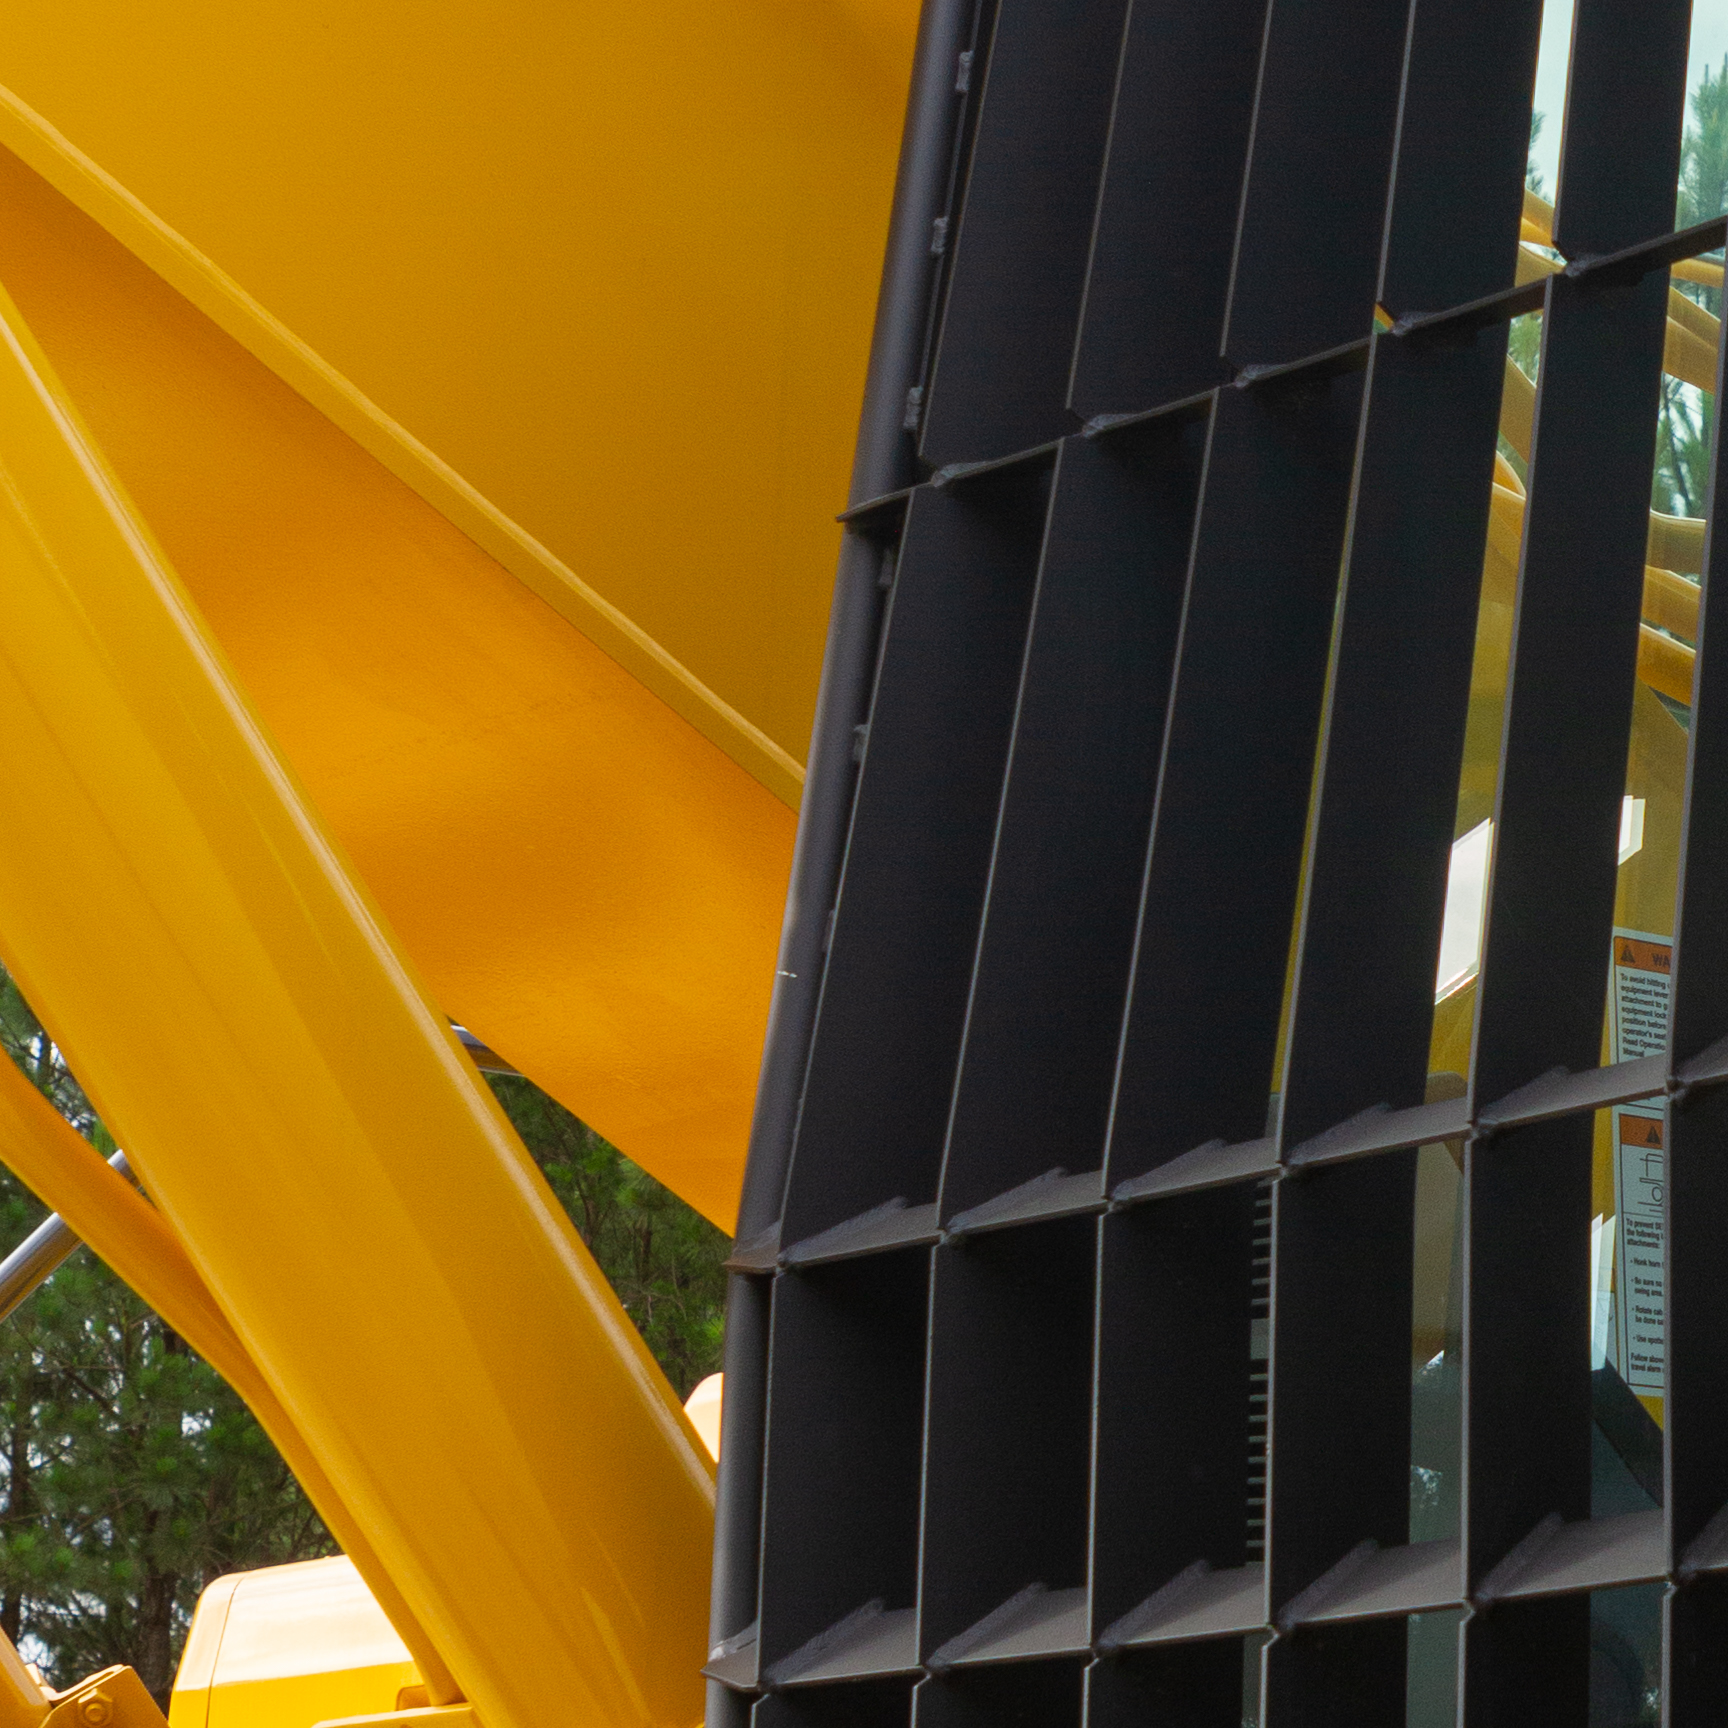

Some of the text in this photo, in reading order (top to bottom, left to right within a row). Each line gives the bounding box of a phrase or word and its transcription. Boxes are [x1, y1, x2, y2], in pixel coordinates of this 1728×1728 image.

[1621, 973, 1629, 981] To
[1630, 976, 1646, 985] avoid
[1621, 985, 1652, 996] equipment
[1622, 995, 1654, 1006] attachment
[1622, 1006, 1653, 1017] equipment
[1622, 1016, 1646, 1027] position
[1623, 1036, 1638, 1046] Read
[1623, 1047, 1644, 1058] Manual
[1626, 1218, 1633, 1226] To
[1635, 1221, 1654, 1229] prevent
[1627, 1228, 1635, 1236] the
[1636, 1229, 1660, 1241] following
